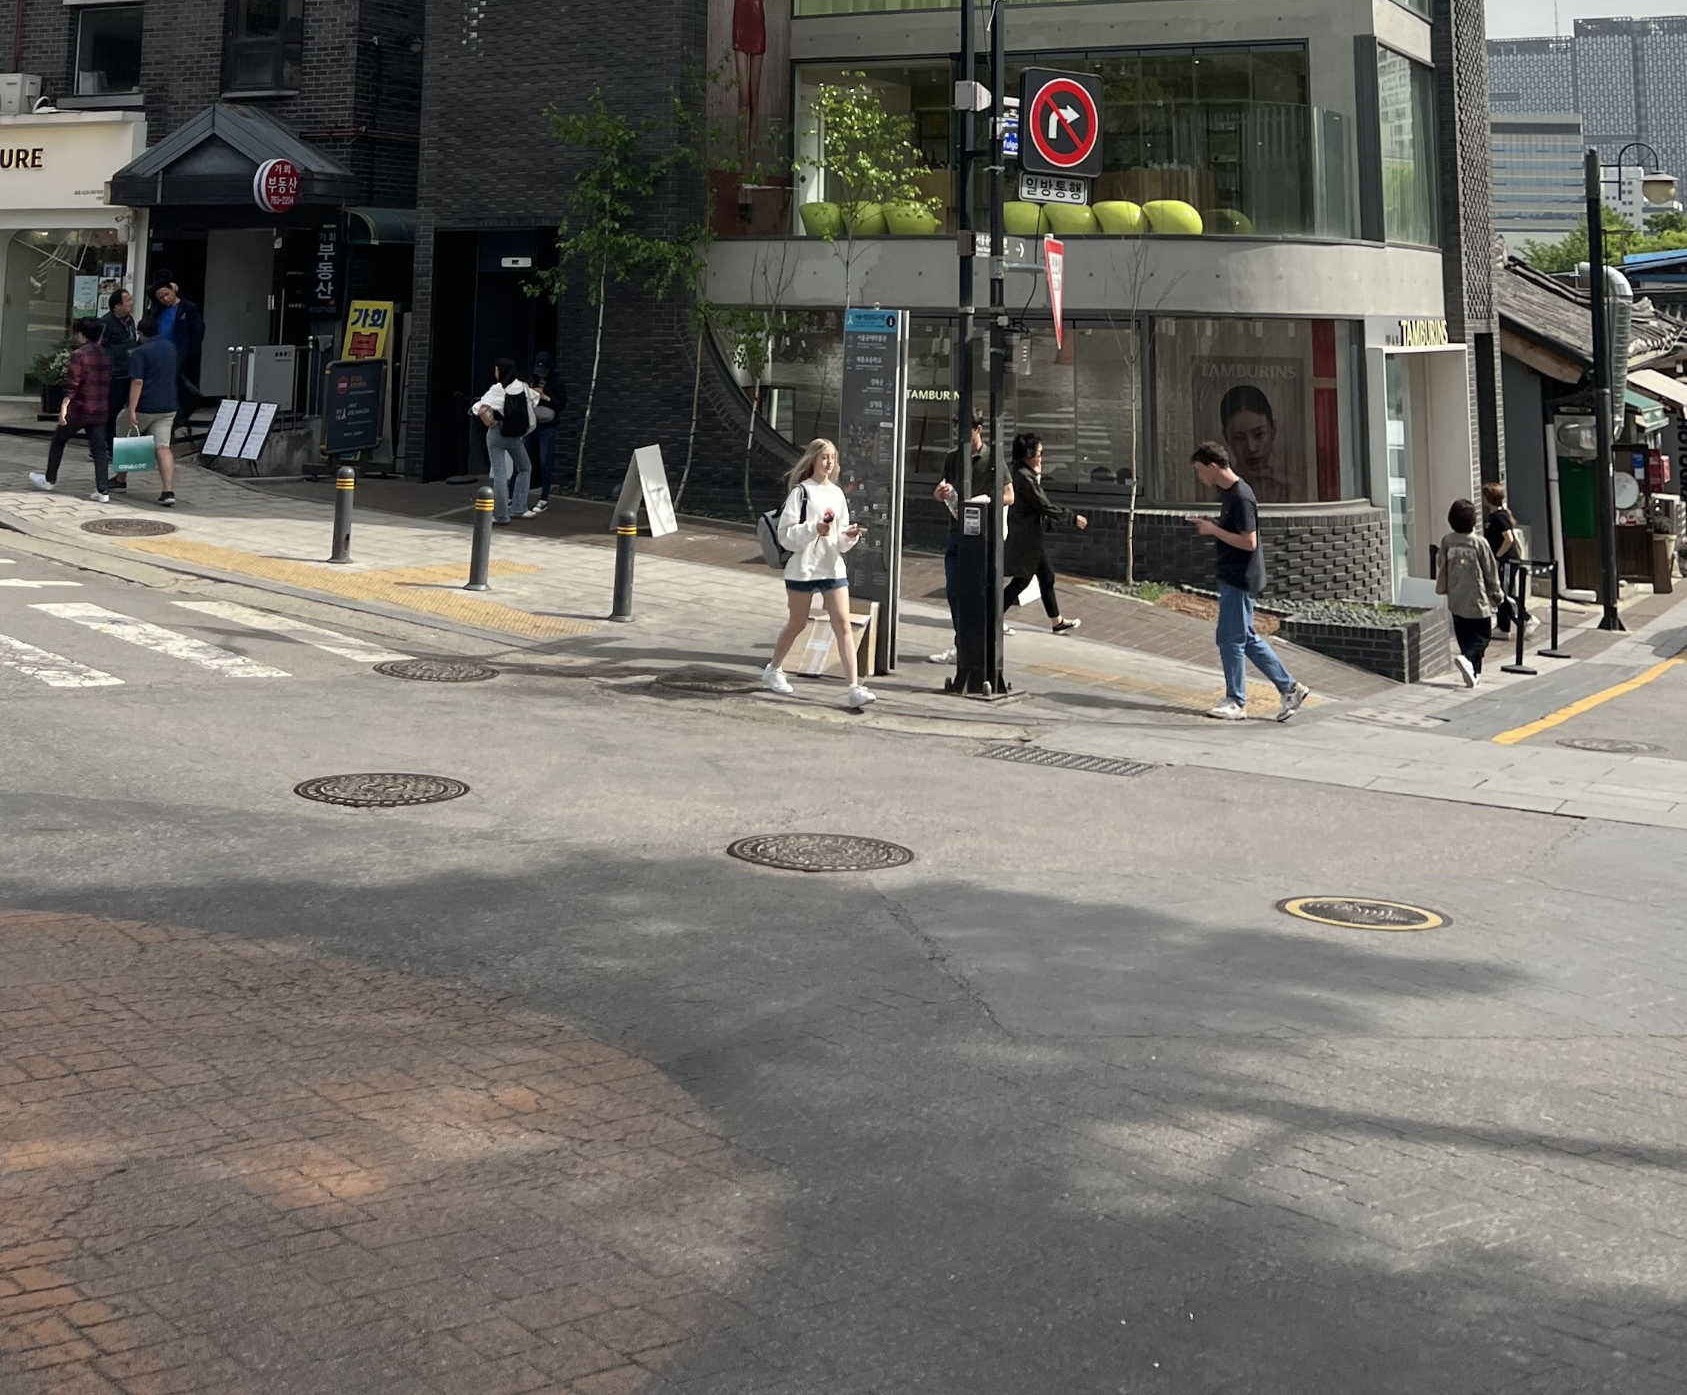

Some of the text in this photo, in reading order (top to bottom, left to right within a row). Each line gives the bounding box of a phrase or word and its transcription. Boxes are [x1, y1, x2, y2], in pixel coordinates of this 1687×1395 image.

[0, 148, 44, 169] URE
[274, 164, 292, 175] 가회
[267, 176, 298, 194] 부동산
[1025, 177, 1083, 201] 일방통행
[315, 243, 336, 299] 부동산
[351, 308, 388, 329] 가회
[1399, 319, 1449, 346] TAMBURINS
[1200, 363, 1297, 379] TAMBURINS
